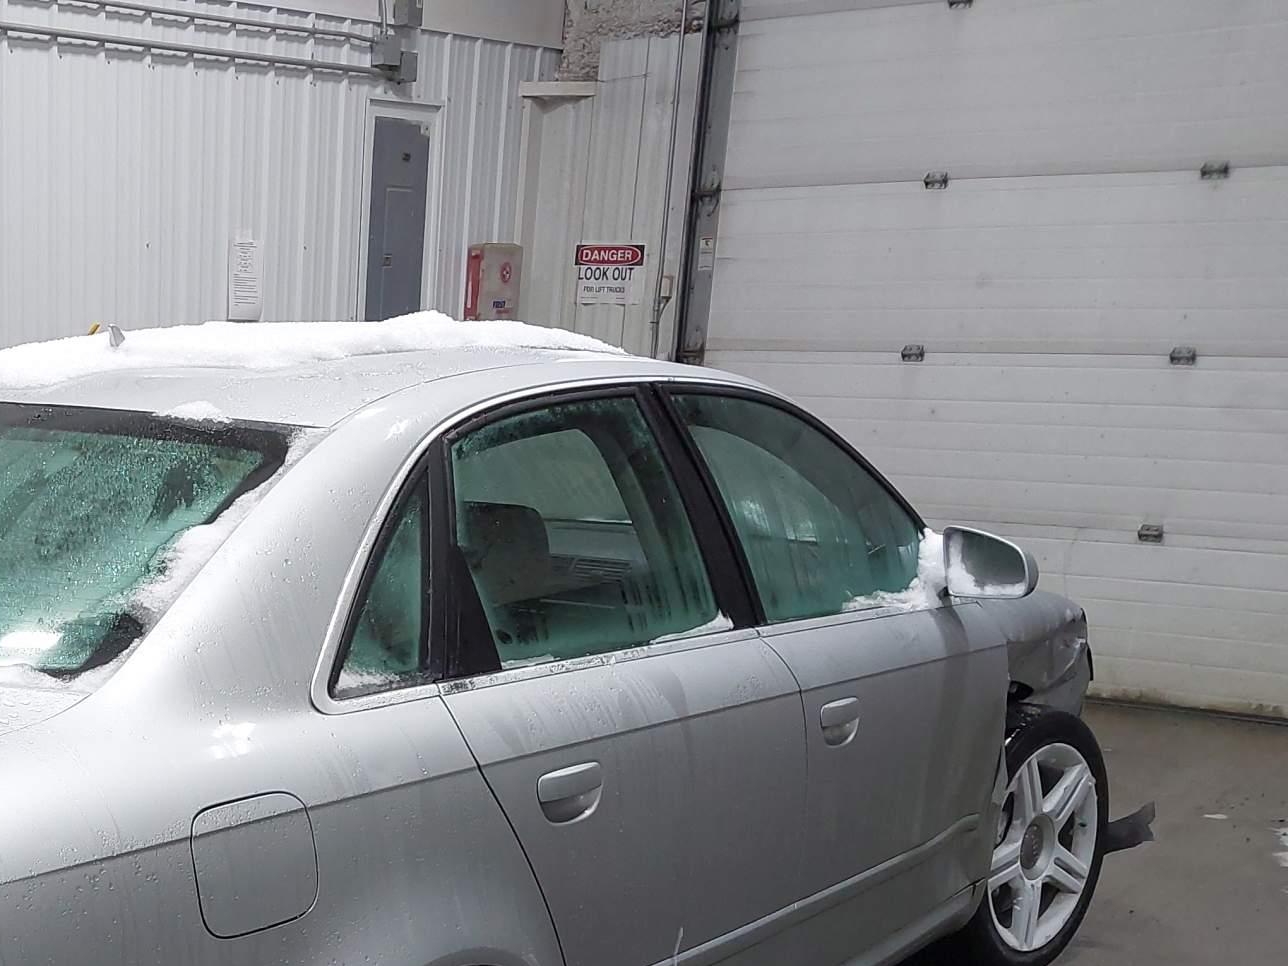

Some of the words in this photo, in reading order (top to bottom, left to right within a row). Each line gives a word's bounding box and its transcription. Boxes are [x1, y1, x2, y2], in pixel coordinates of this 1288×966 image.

[582, 249, 633, 261] DANGER
[578, 267, 610, 281] LOOK
[612, 267, 635, 281] OUT
